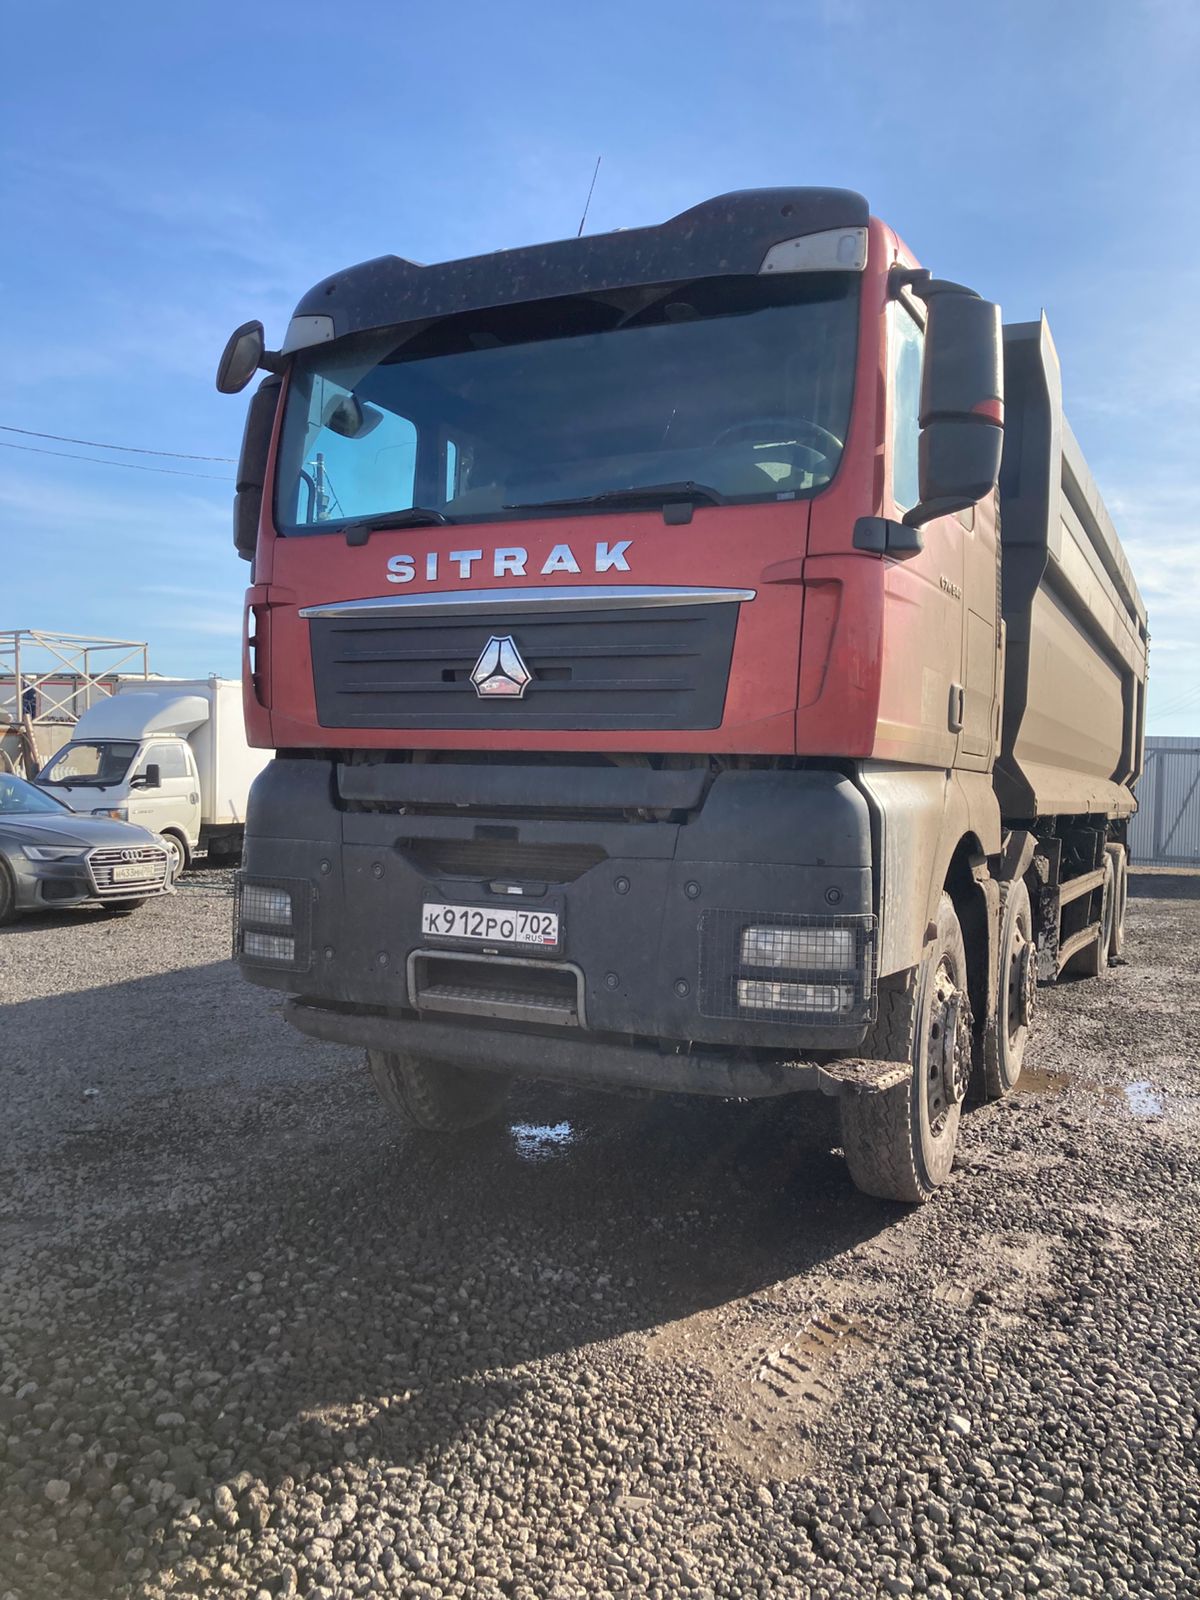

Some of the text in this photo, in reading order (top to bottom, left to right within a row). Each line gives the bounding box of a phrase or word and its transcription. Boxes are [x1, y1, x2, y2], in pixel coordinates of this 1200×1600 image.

[386, 540, 633, 584] SITRAK
[518, 914, 553, 936] 702
[525, 933, 543, 943] RUS
